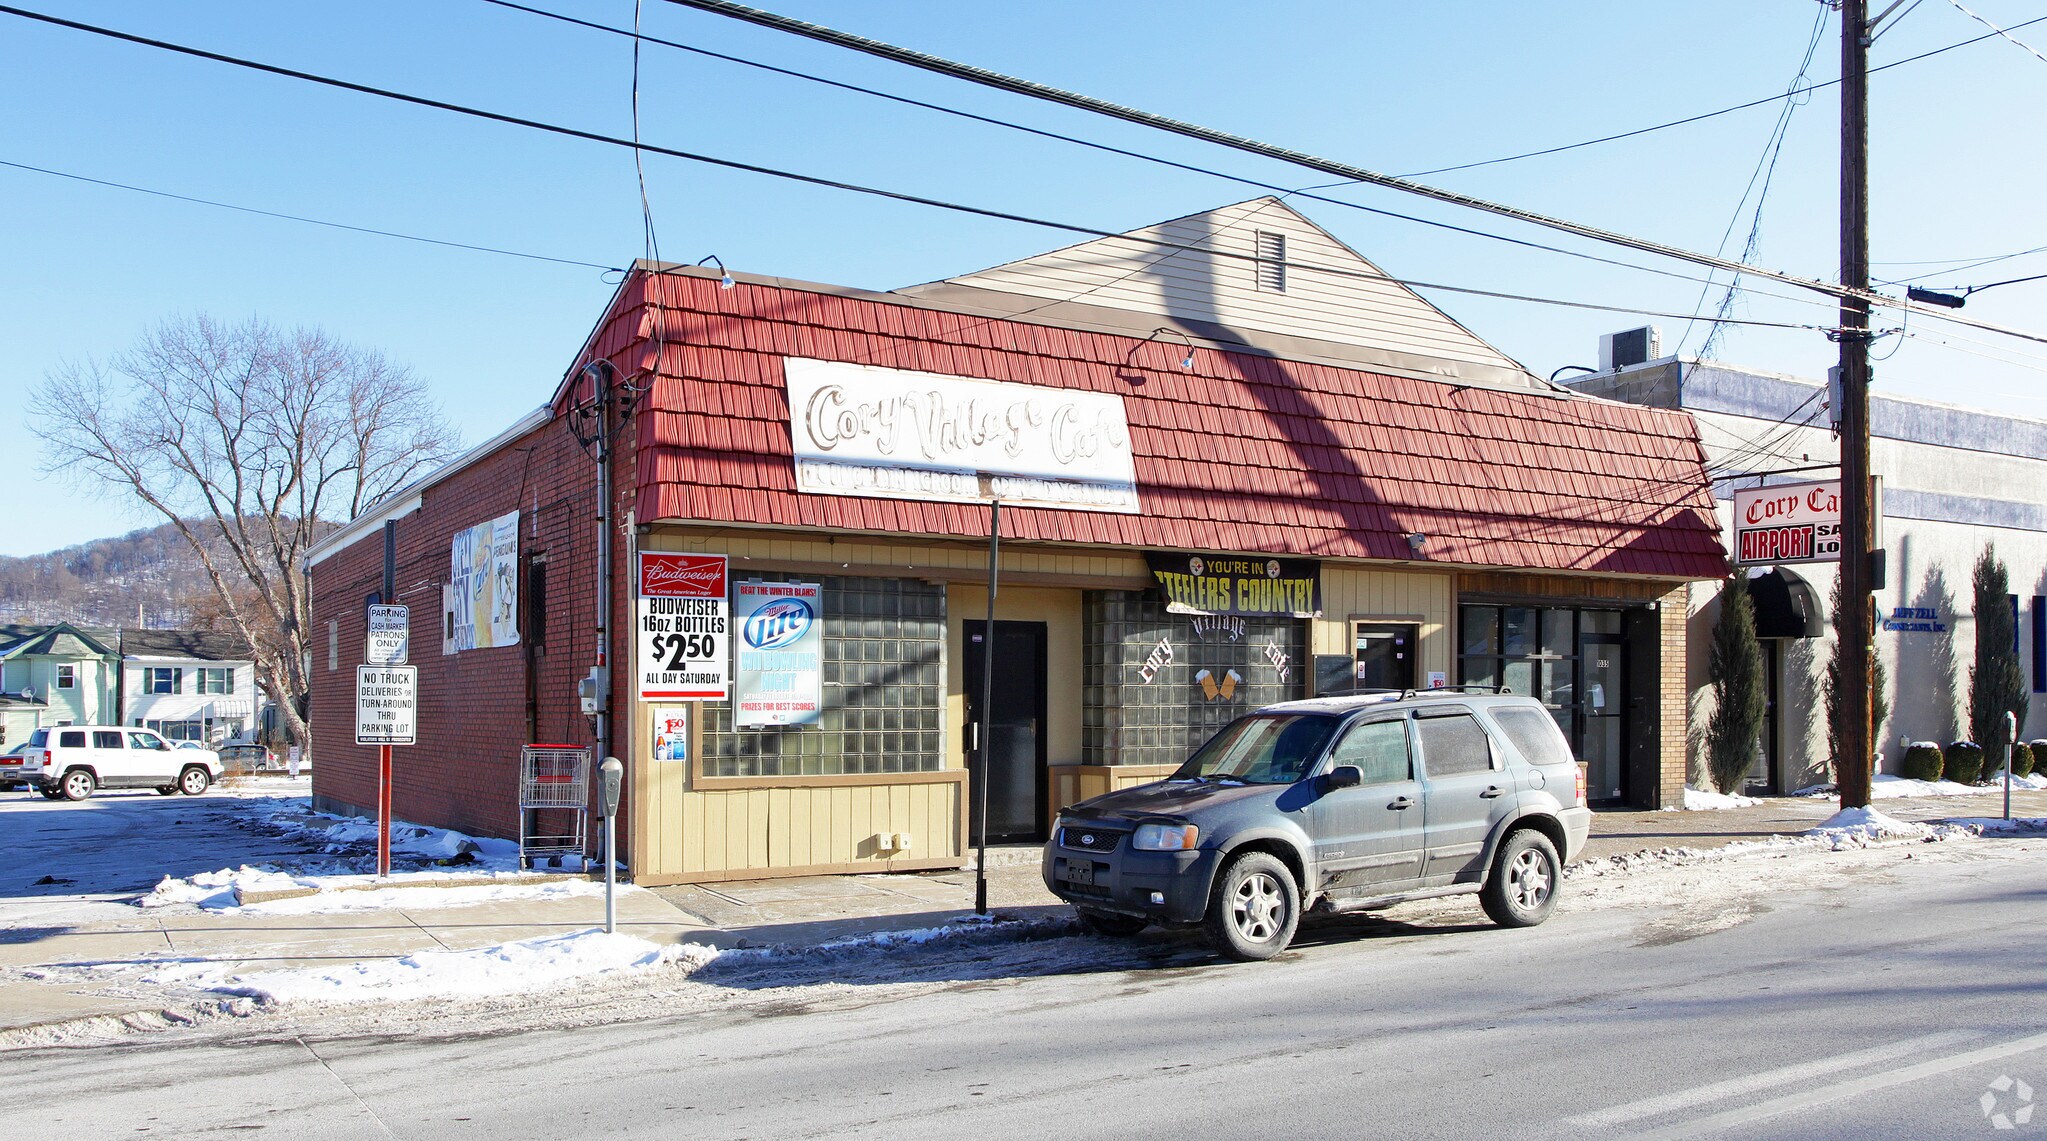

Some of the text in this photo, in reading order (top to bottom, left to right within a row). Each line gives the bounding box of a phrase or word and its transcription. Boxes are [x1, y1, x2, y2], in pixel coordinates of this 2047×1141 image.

[806, 384, 901, 456] Cory
[903, 390, 1043, 462] Village
[1746, 487, 1842, 524] Cory Ca
[1817, 524, 1841, 536] SA
[1741, 527, 1813, 560] AIRPORT
[1817, 542, 1840, 553] LO
[644, 564, 722, 581] Budweiser
[1206, 561, 1264, 574] YOU'RE IN
[740, 585, 816, 597] BEAT THE WINTER BLAHS!
[1237, 578, 1314, 613] COUNTRY
[649, 597, 718, 616] BUDWEISER
[765, 604, 789, 617] Miller
[371, 609, 406, 618] PARKING
[371, 622, 405, 630] CASH MARKET
[675, 616, 725, 633] BOTTLES
[754, 607, 804, 649] Lite
[1190, 614, 1247, 643] Village
[371, 631, 405, 639] PATRONS
[763, 651, 816, 671] BOWLING
[364, 673, 409, 684] NO TRUCK
[646, 673, 721, 684] ALL DAY SATURDAY
[761, 672, 797, 691] NIGHT
[361, 687, 403, 696] DELIVERIES
[361, 699, 412, 708] TURN-AROUND
[740, 702, 815, 711] PRIZES FOR BEST SCORES
[377, 711, 396, 720] THRU
[362, 723, 409, 733] PARKING LOT
